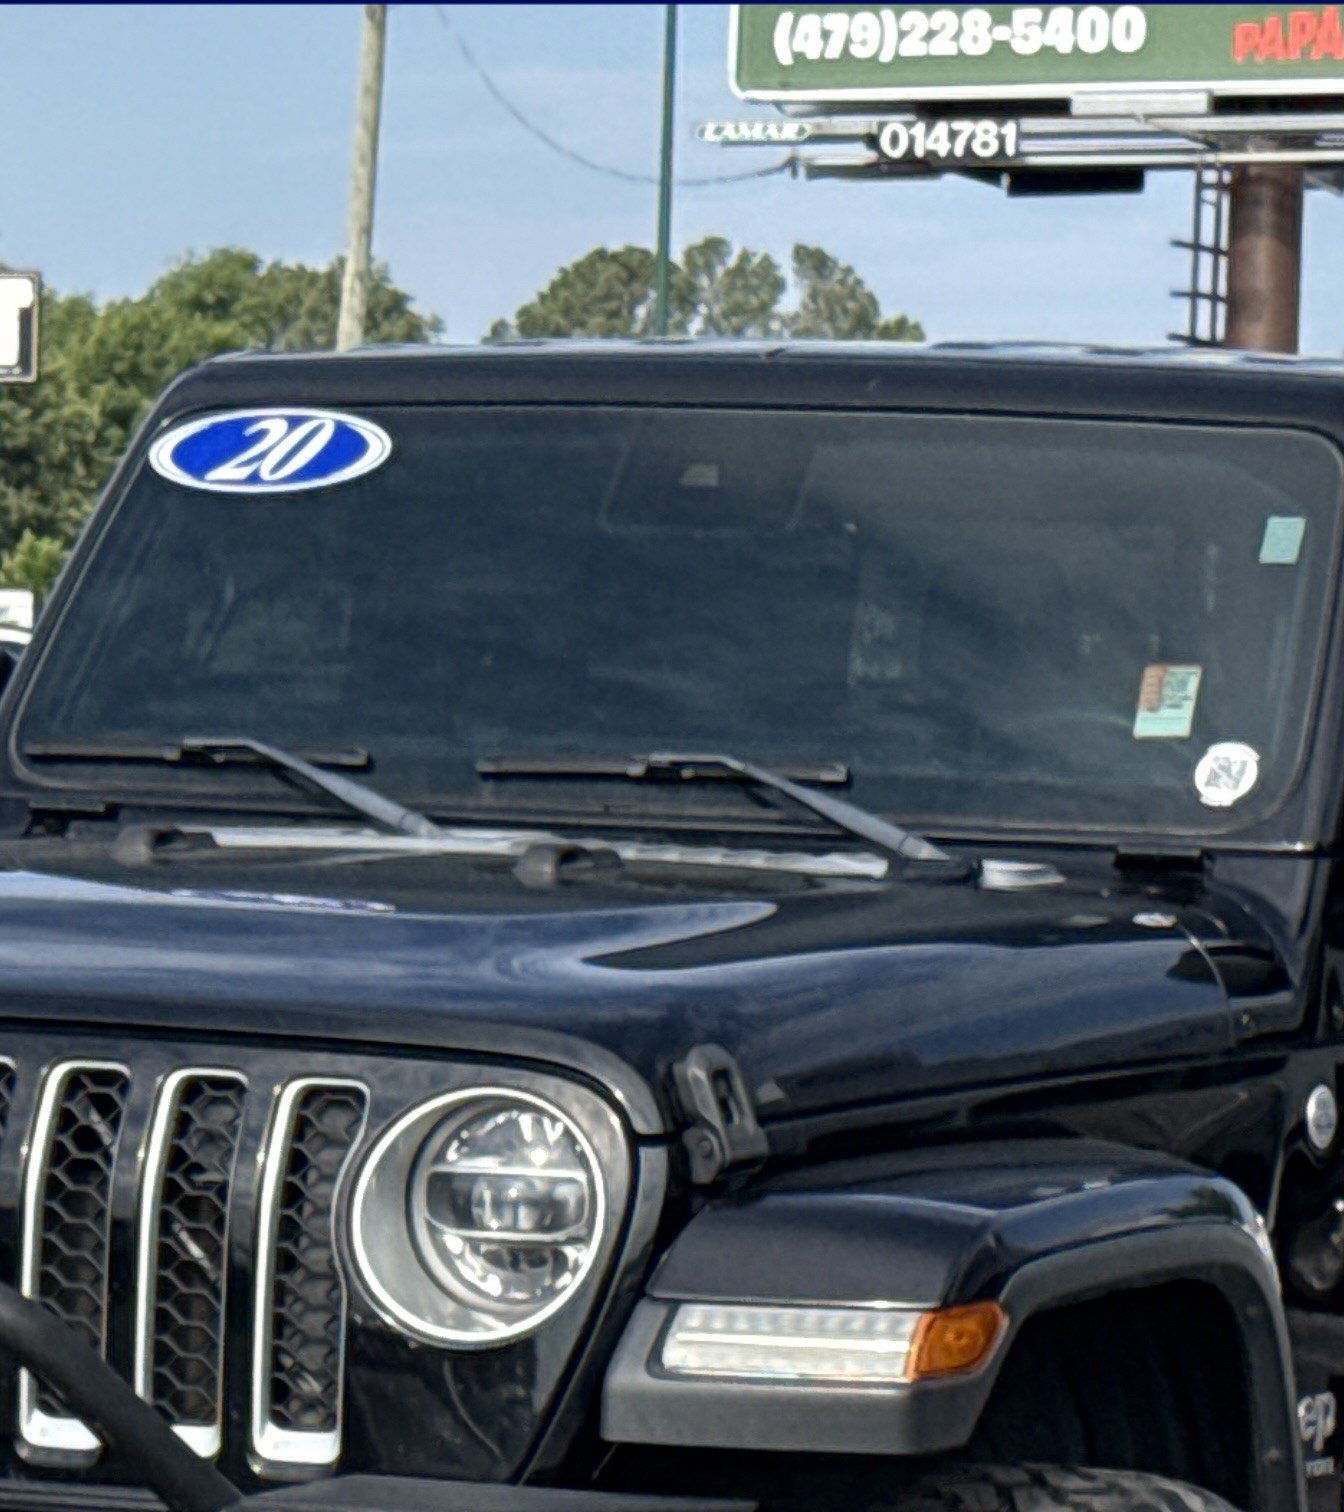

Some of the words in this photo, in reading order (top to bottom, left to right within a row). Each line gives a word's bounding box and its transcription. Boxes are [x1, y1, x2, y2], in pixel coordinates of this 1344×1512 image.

[773, 6, 1147, 65] (479)228-5400
[879, 120, 1017, 159] 014781
[203, 418, 335, 481] 20
[1297, 1391, 1336, 1453] ep
